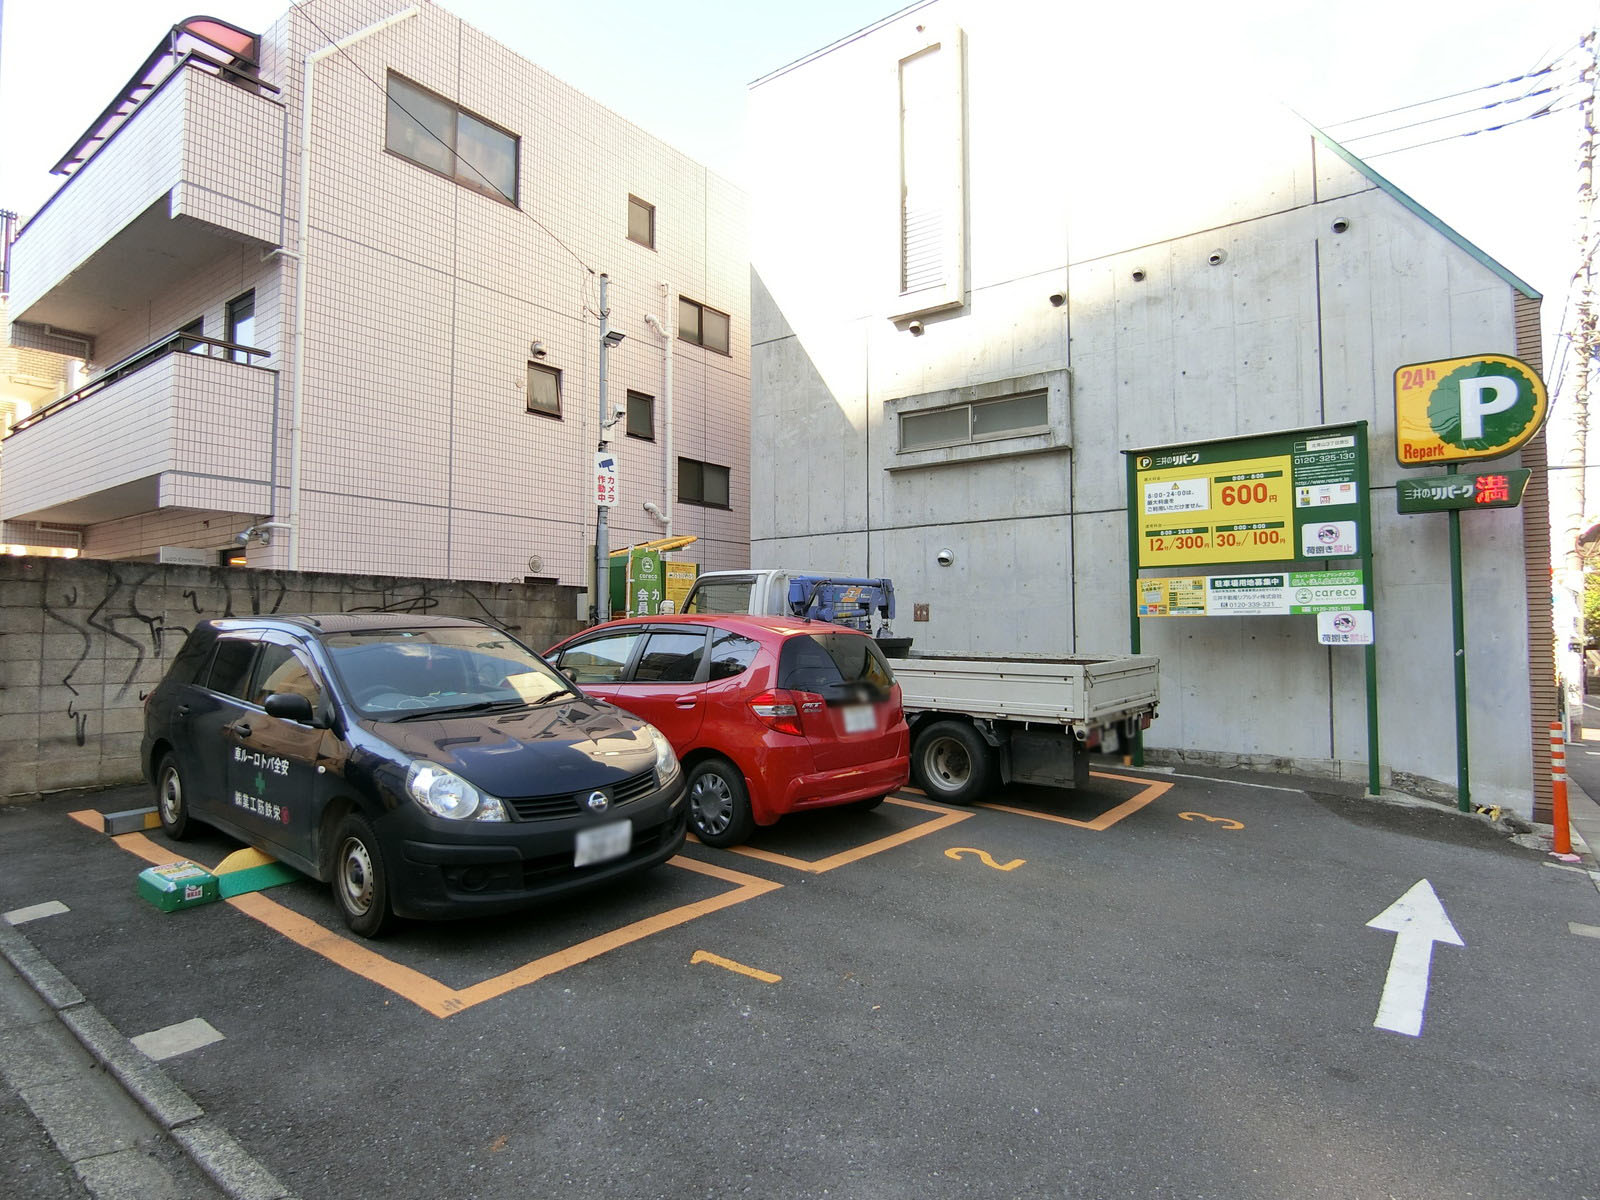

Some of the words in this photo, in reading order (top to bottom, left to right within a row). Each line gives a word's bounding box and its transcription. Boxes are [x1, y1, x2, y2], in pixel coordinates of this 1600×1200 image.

[1401, 368, 1436, 390] 24h
[1459, 375, 1519, 440] P
[1155, 453, 1200, 465] 三井のリパーク
[1294, 452, 1356, 465] 0120-325-130
[1403, 443, 1445, 460] Repark
[597, 475, 606, 502] 作動中
[607, 476, 615, 502] カメラ
[1404, 485, 1474, 501] 三井のリパーク
[1475, 475, 1509, 503] 満
[637, 588, 649, 617] 会員
[1315, 588, 1357, 598] careco
[1178, 811, 1245, 831] 3
[944, 846, 1027, 871] 2
[690, 950, 783, 984] 1
